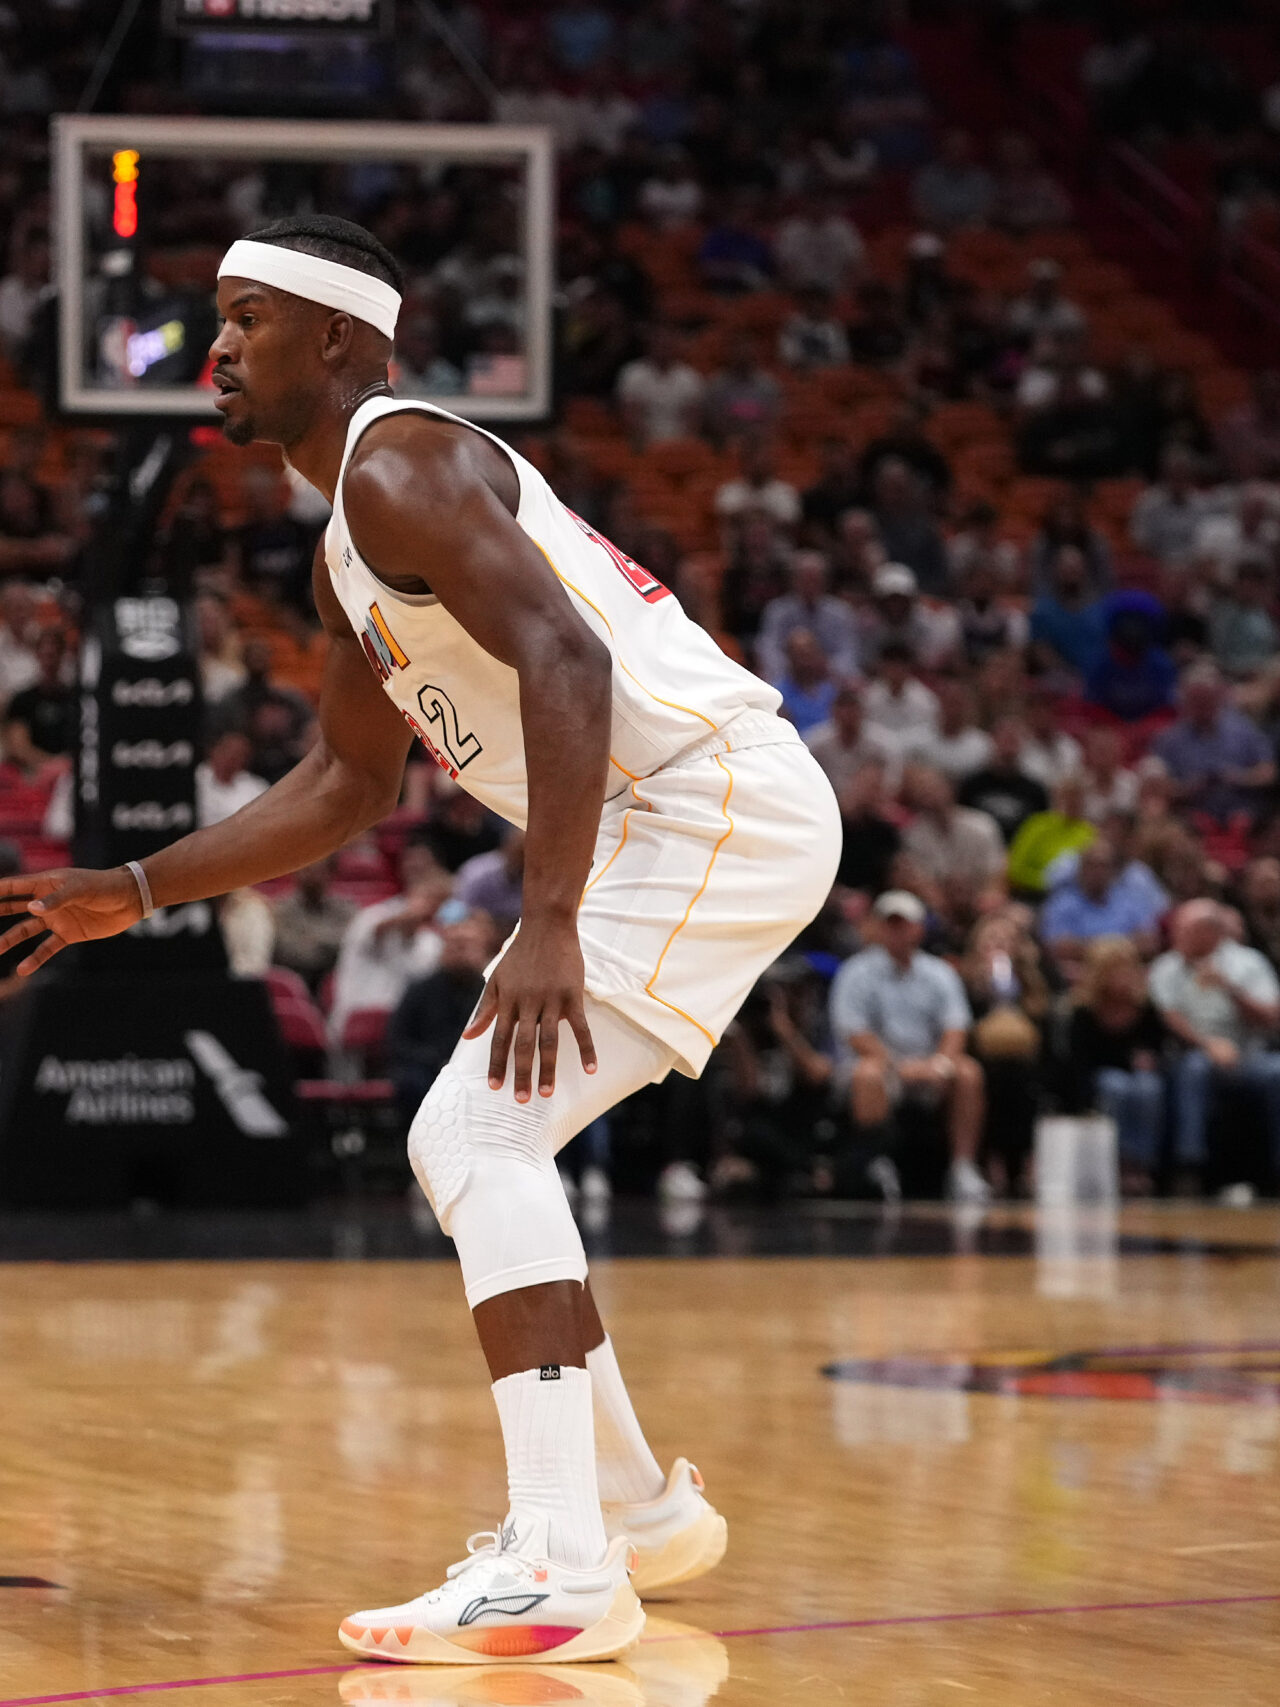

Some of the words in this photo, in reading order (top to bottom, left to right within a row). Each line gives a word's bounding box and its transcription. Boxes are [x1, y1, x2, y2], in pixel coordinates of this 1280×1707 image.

[35, 1055, 195, 1093] American
[67, 1088, 195, 1124] Airlines
[541, 1366, 559, 1379] alo
